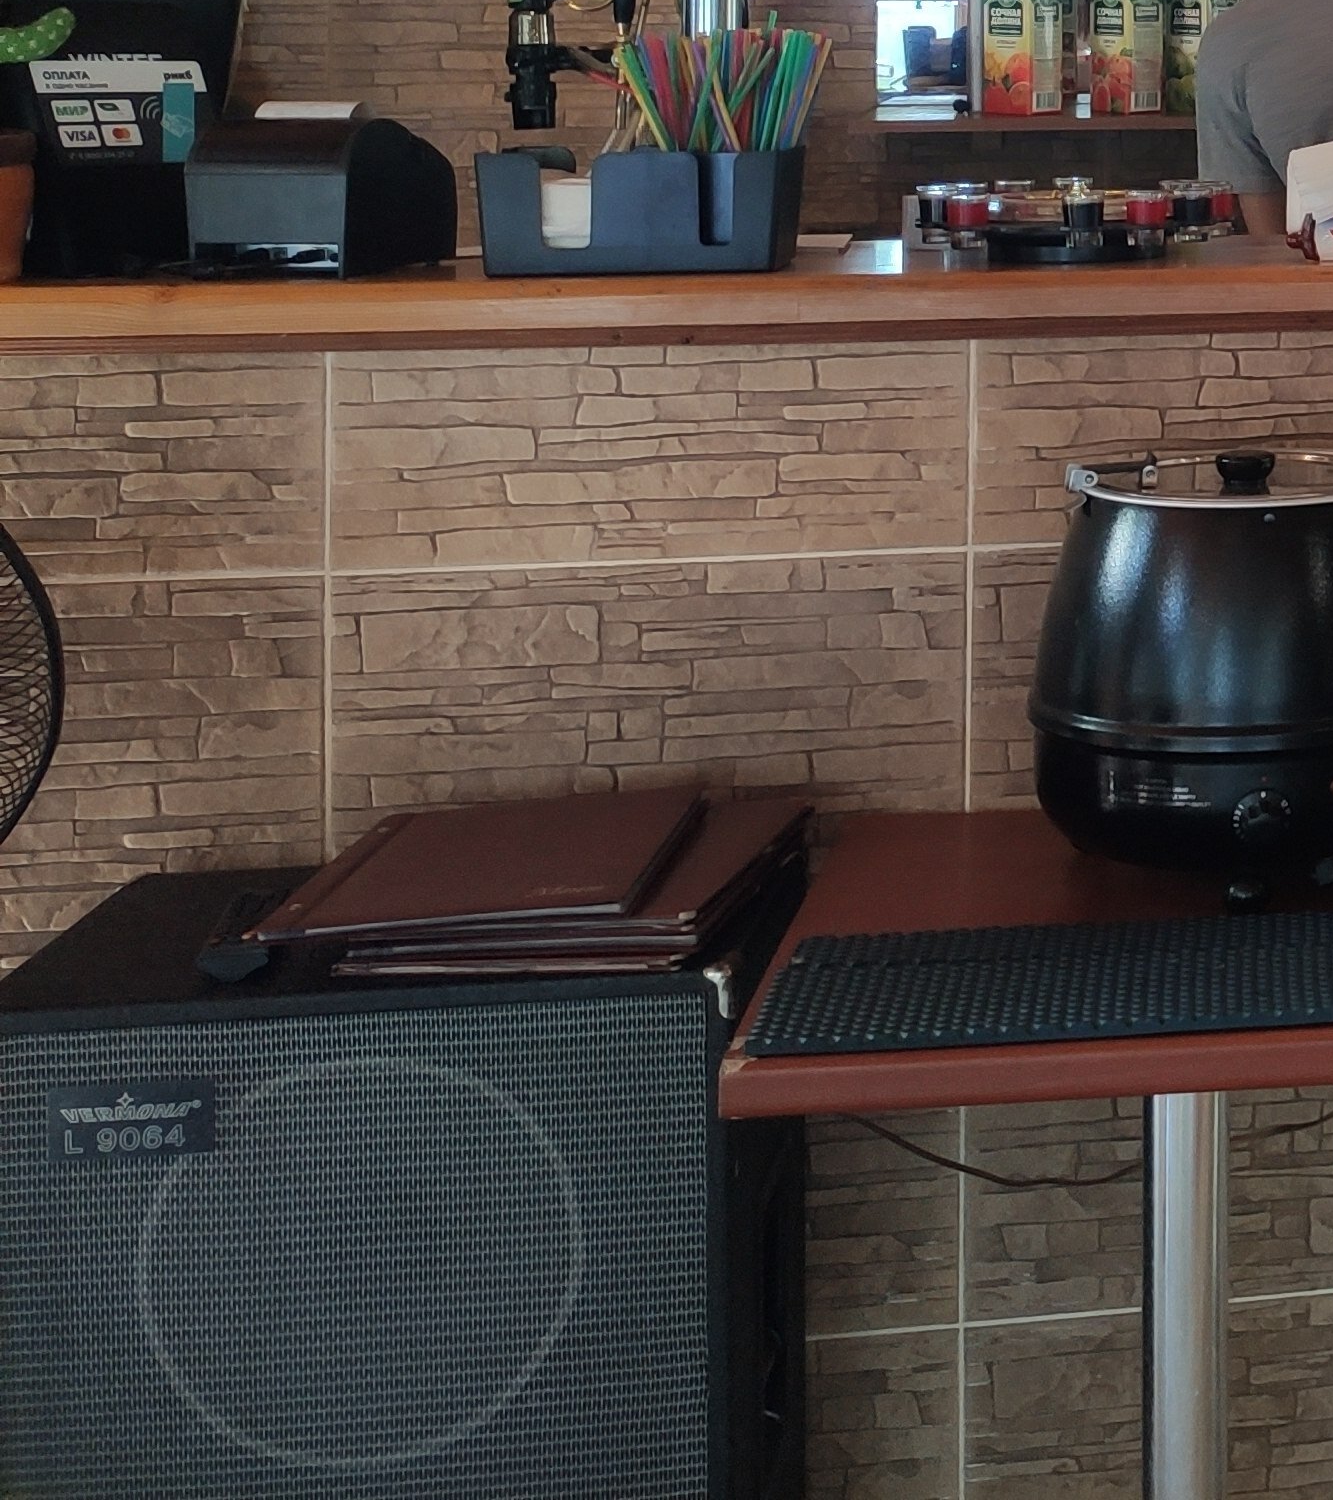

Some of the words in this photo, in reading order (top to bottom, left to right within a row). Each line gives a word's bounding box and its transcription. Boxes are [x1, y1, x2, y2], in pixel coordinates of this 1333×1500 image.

[42, 70, 91, 81] ОПЛАТА
[63, 130, 98, 142] VISA
[64, 1129, 84, 1155] L
[96, 1123, 187, 1153] 9064
